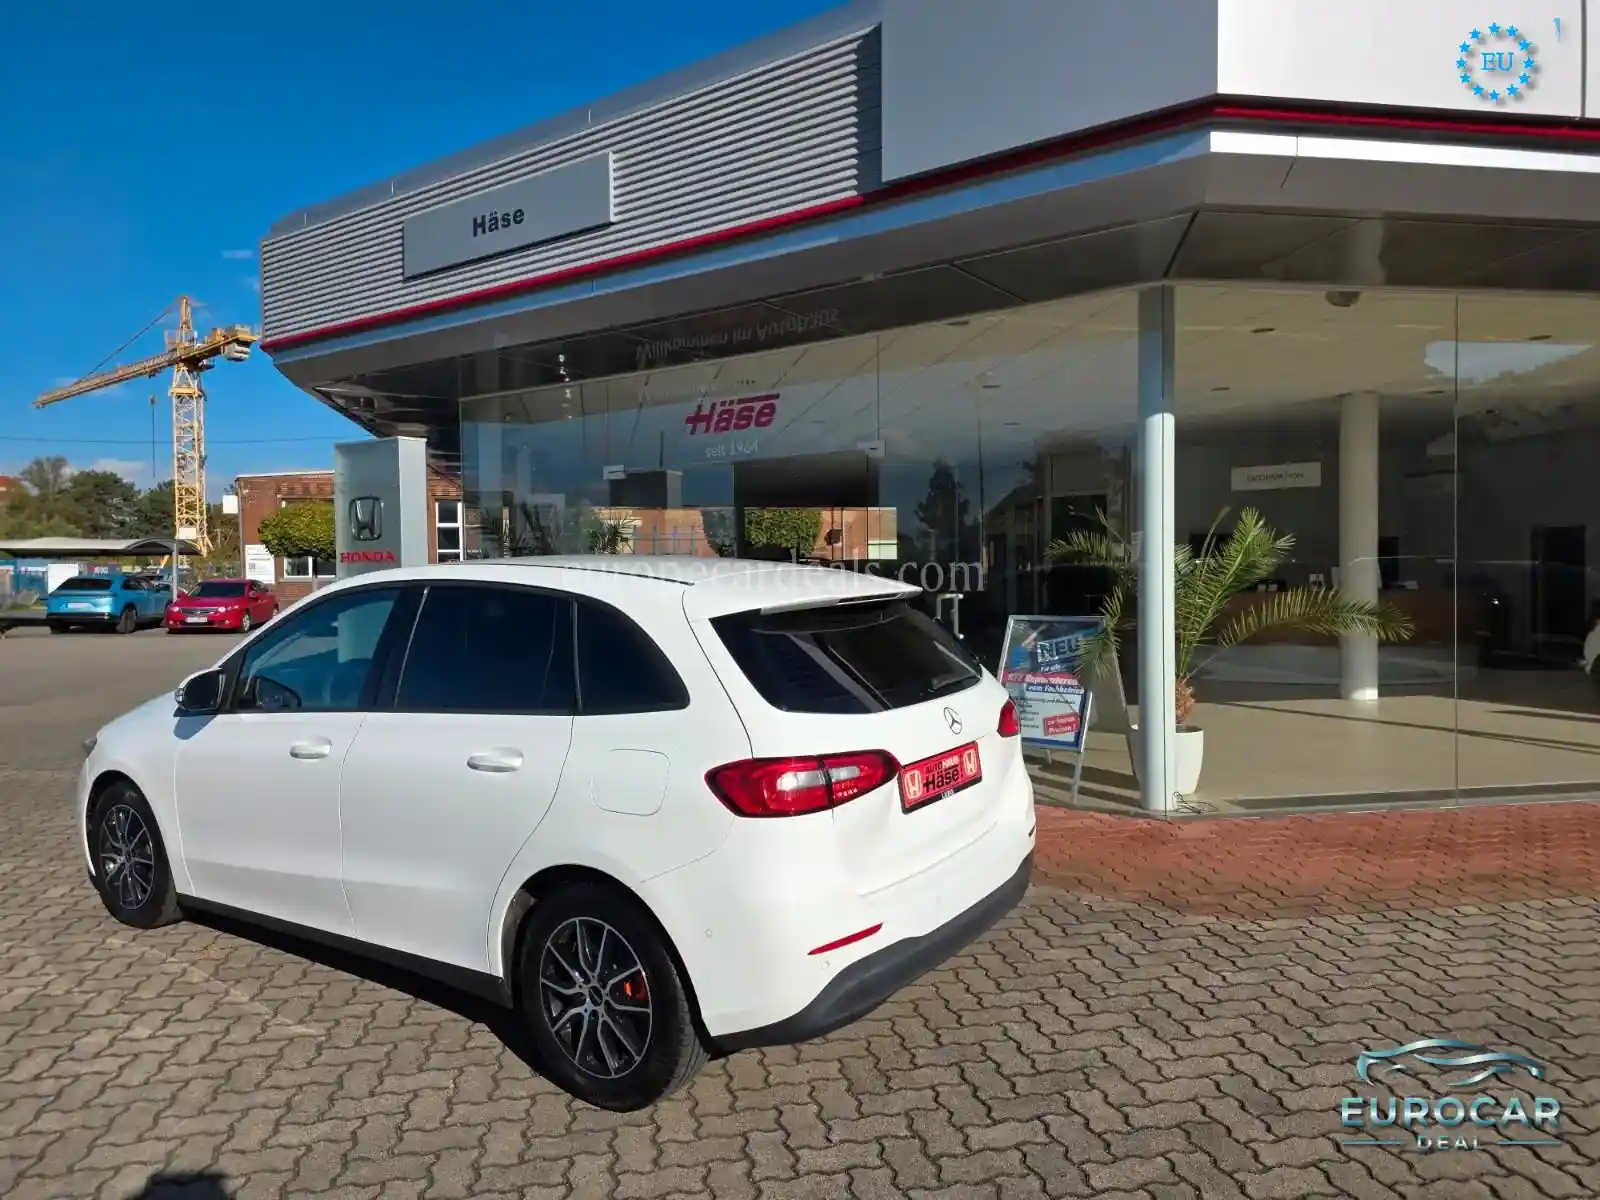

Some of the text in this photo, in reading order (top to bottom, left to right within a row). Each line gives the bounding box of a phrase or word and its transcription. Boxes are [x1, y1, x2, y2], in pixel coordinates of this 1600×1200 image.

[473, 208, 525, 237] Häse
[685, 393, 780, 435] Häse
[340, 549, 396, 563] HONDA
[922, 766, 960, 792] Häse
